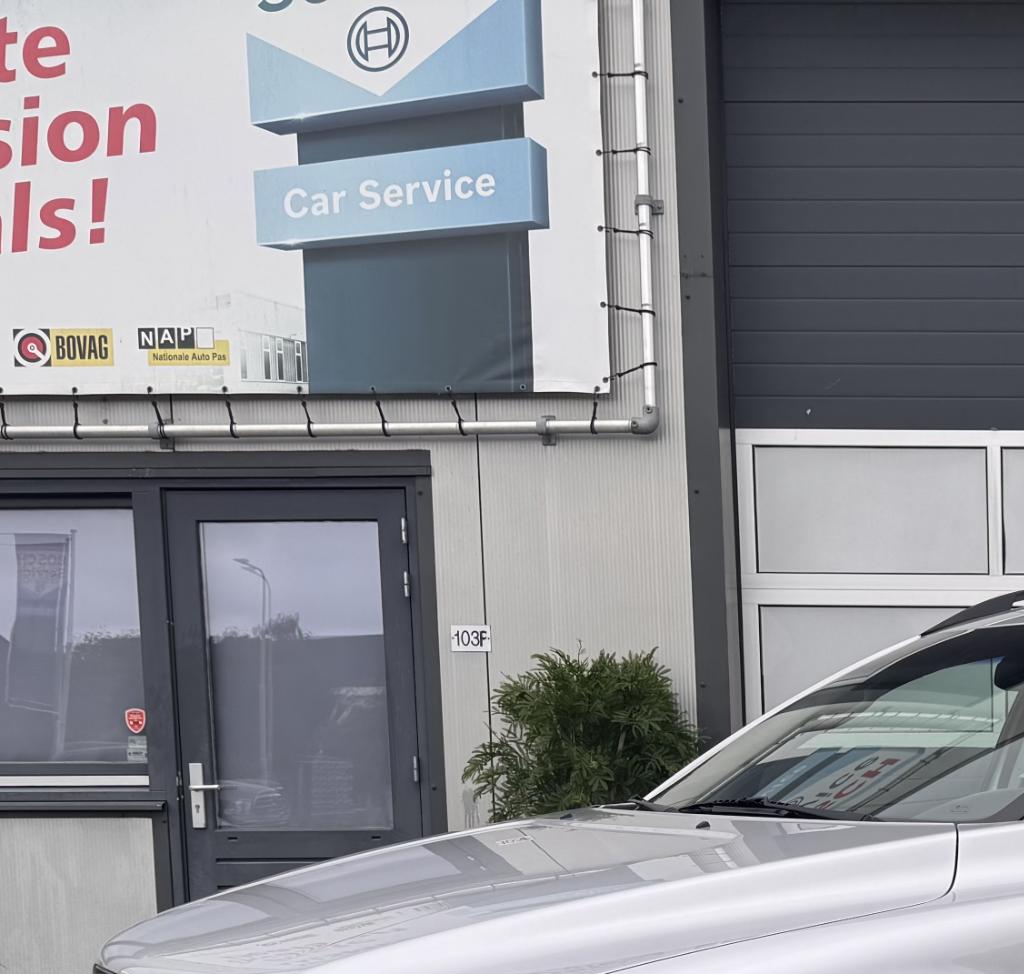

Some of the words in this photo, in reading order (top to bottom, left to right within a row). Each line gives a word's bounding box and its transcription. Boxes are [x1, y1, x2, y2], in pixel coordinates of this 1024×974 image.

[283, 187, 346, 219] Car
[359, 169, 496, 210] Service
[0, 178, 108, 255] ls!
[56, 335, 108, 360] BOVAG
[140, 327, 193, 347] NAP
[152, 352, 189, 361] Nationale
[191, 352, 210, 361] Auto
[212, 352, 226, 361] Pas
[454, 630, 487, 647] 103F
